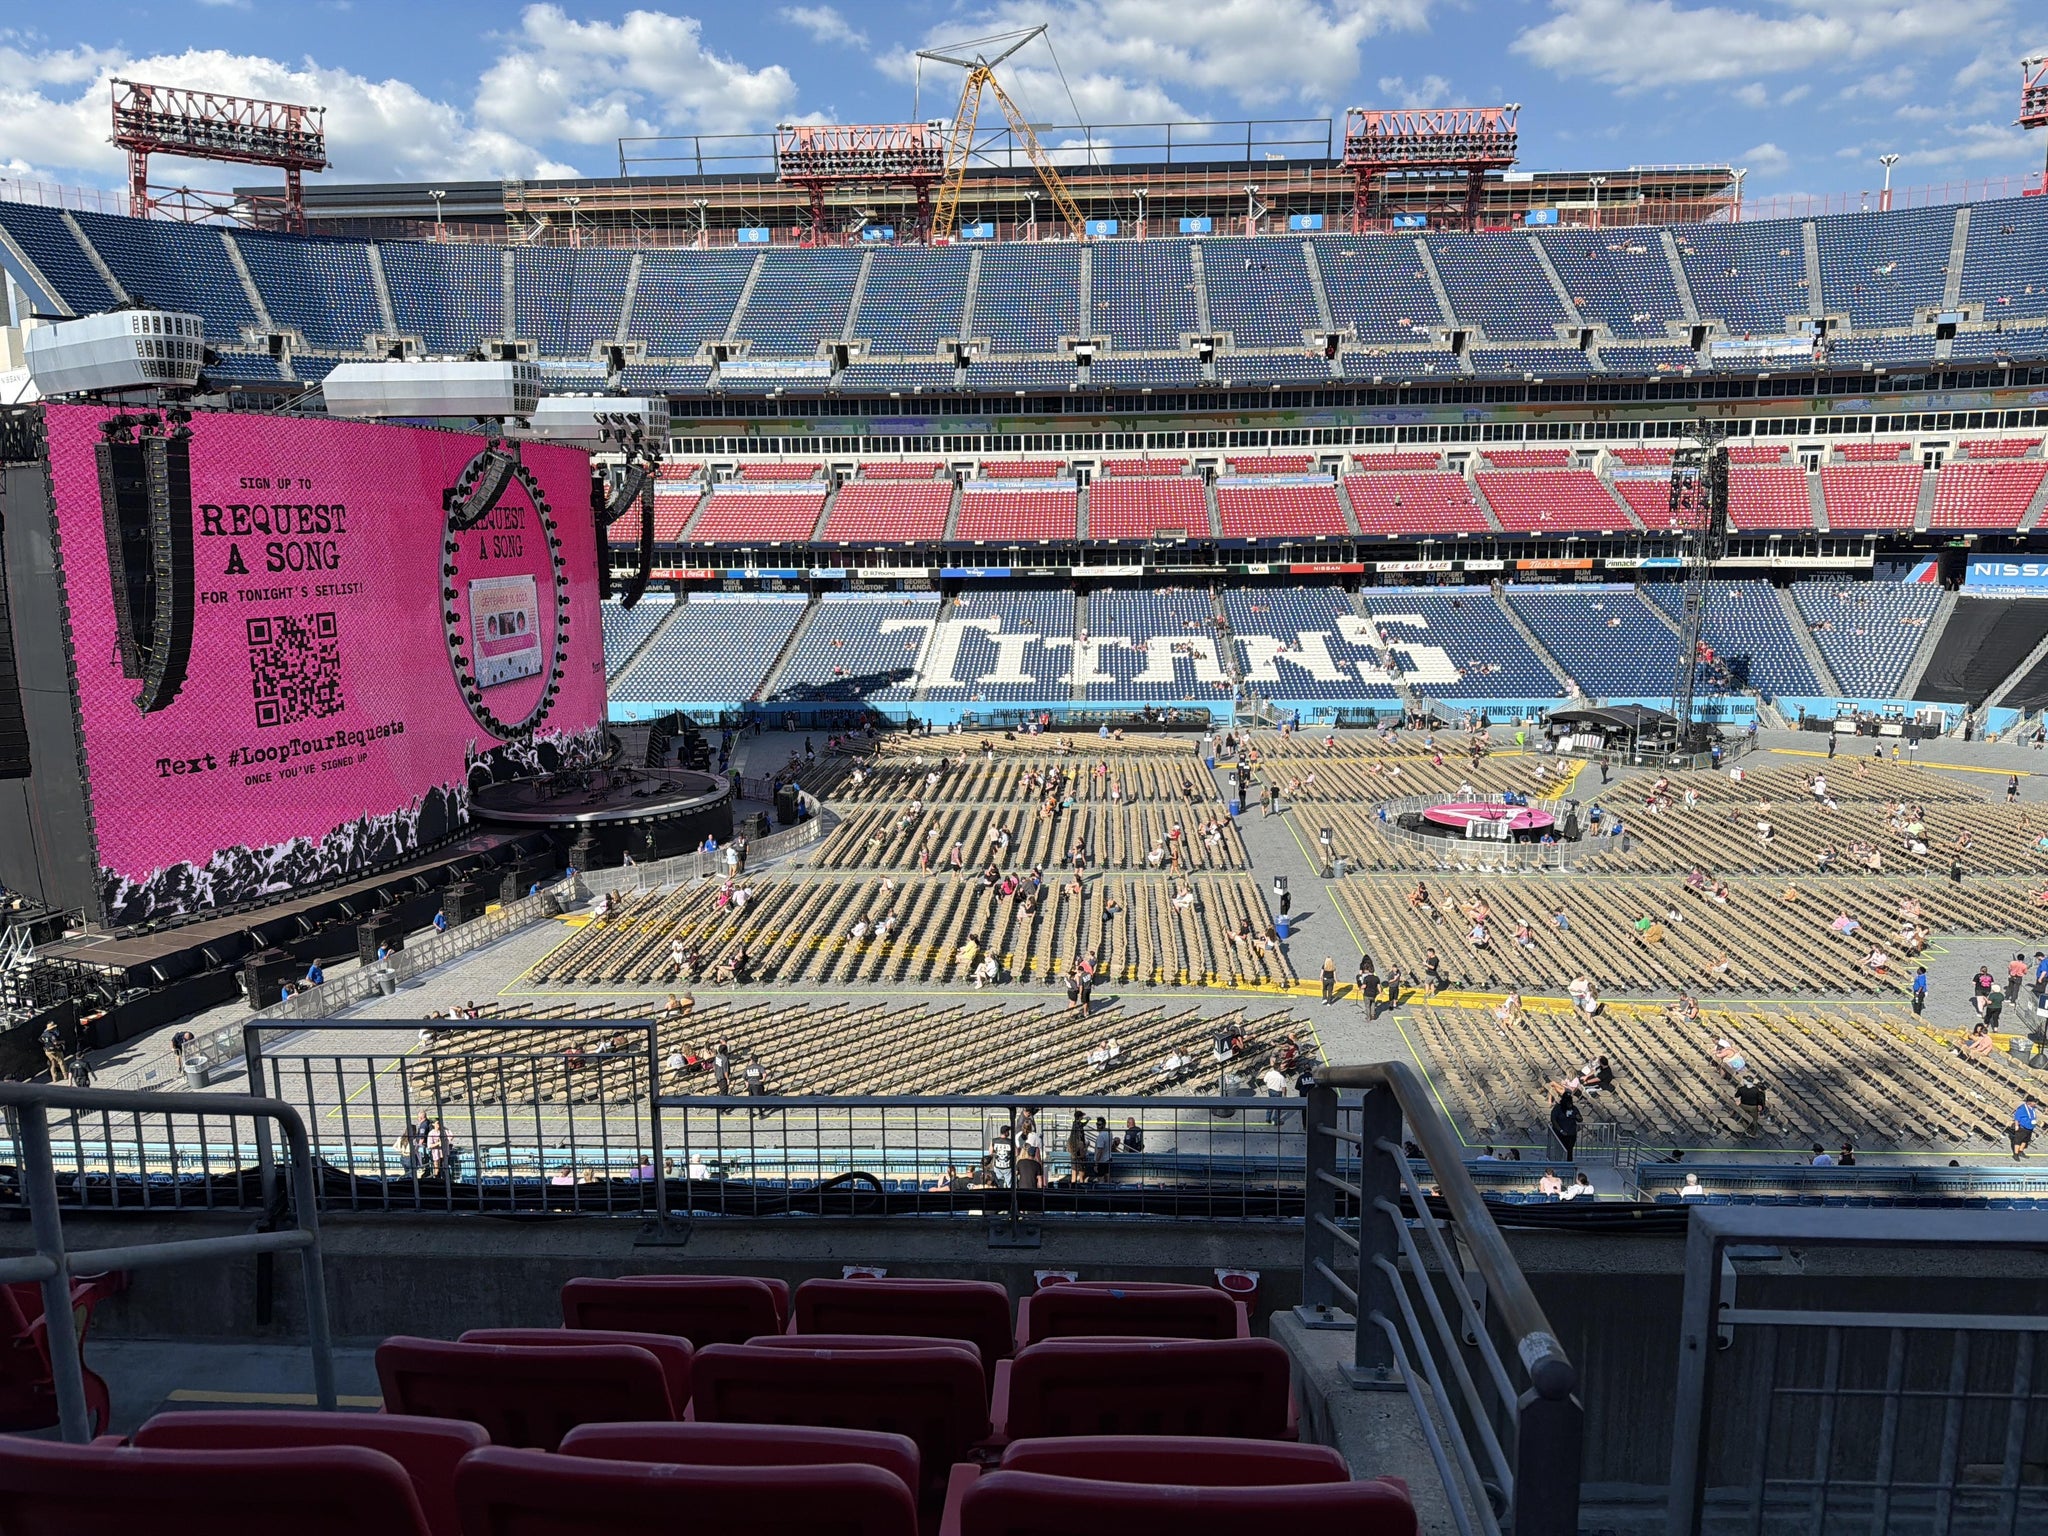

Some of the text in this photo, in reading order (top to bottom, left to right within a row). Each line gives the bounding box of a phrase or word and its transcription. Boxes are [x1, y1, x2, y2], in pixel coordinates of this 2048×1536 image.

[240, 478, 312, 490] SIGN UP TO
[198, 504, 346, 536] REQUEST
[224, 541, 341, 574] A SONG
[480, 535, 523, 560] A SONG
[201, 582, 364, 604] FOR TONIGHT'S SETLIST!
[880, 614, 1465, 689] TITANS
[1486, 706, 1524, 716] TENNESSEE
[1691, 704, 1728, 714] TENNESSEE
[156, 721, 404, 778] Text #LoopTourRequests
[245, 752, 368, 786] ONCE YOU'VE SIGNED UP
[1223, 1041, 1230, 1052] A
